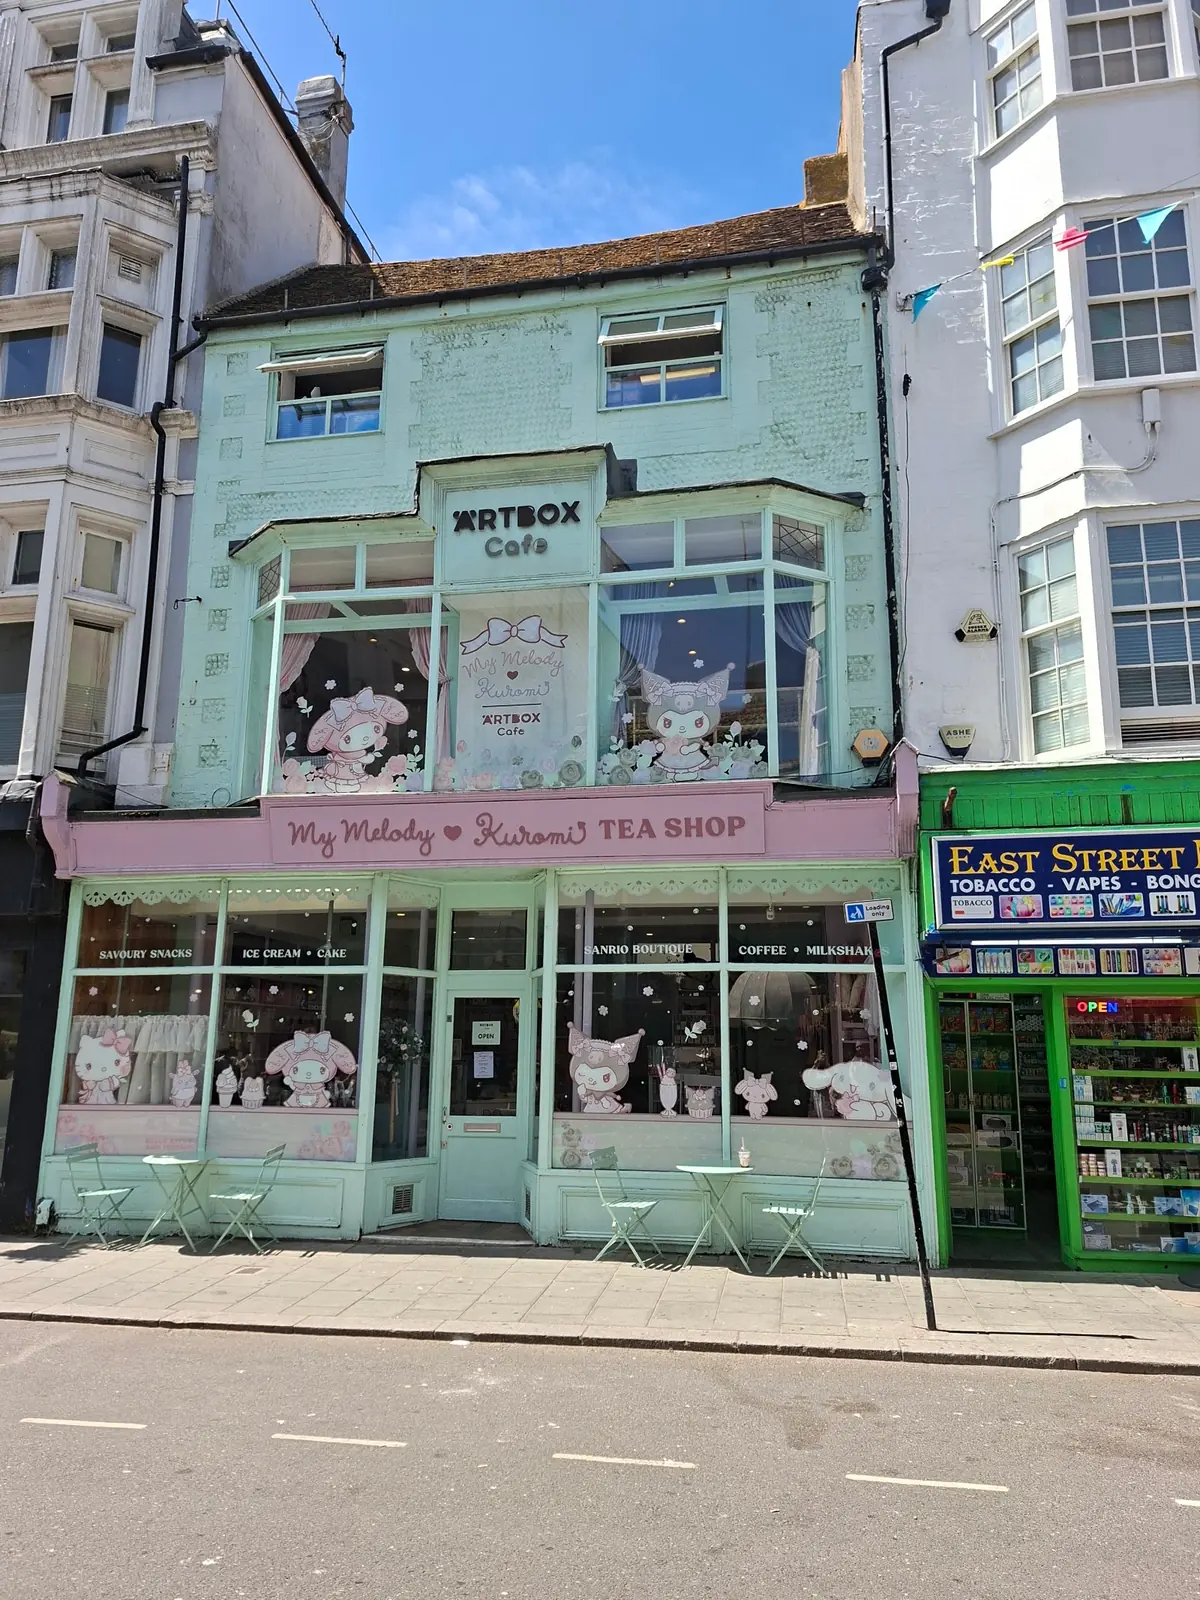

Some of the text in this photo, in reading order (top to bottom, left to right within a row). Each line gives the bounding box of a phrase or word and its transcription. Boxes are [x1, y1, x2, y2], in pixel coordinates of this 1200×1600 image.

[453, 501, 580, 532] ARTBOX
[485, 534, 548, 557] Cafe
[462, 650, 564, 678] My Melody
[475, 678, 550, 699] Kuromi
[482, 712, 541, 725] ARTBOX
[497, 727, 525, 736] Cafe
[945, 728, 971, 736] ASHE
[288, 812, 746, 859] My Melody Kuromi TEA SHOP
[949, 846, 1040, 875] EAST
[1052, 843, 1185, 874] STREET
[950, 878, 1036, 893] TOBACCO
[1062, 875, 1121, 891] VAPES
[865, 903, 890, 911] Loading
[953, 899, 993, 907] TOBACCO
[99, 948, 193, 959] SAVOURY SNACKS
[243, 948, 347, 959] ICE CREAM CAKE
[584, 943, 693, 956] SANRIO BOUTIQUE
[738, 945, 890, 956] COFFEE MILKSHAKS
[1077, 1001, 1118, 1012] OPEN
